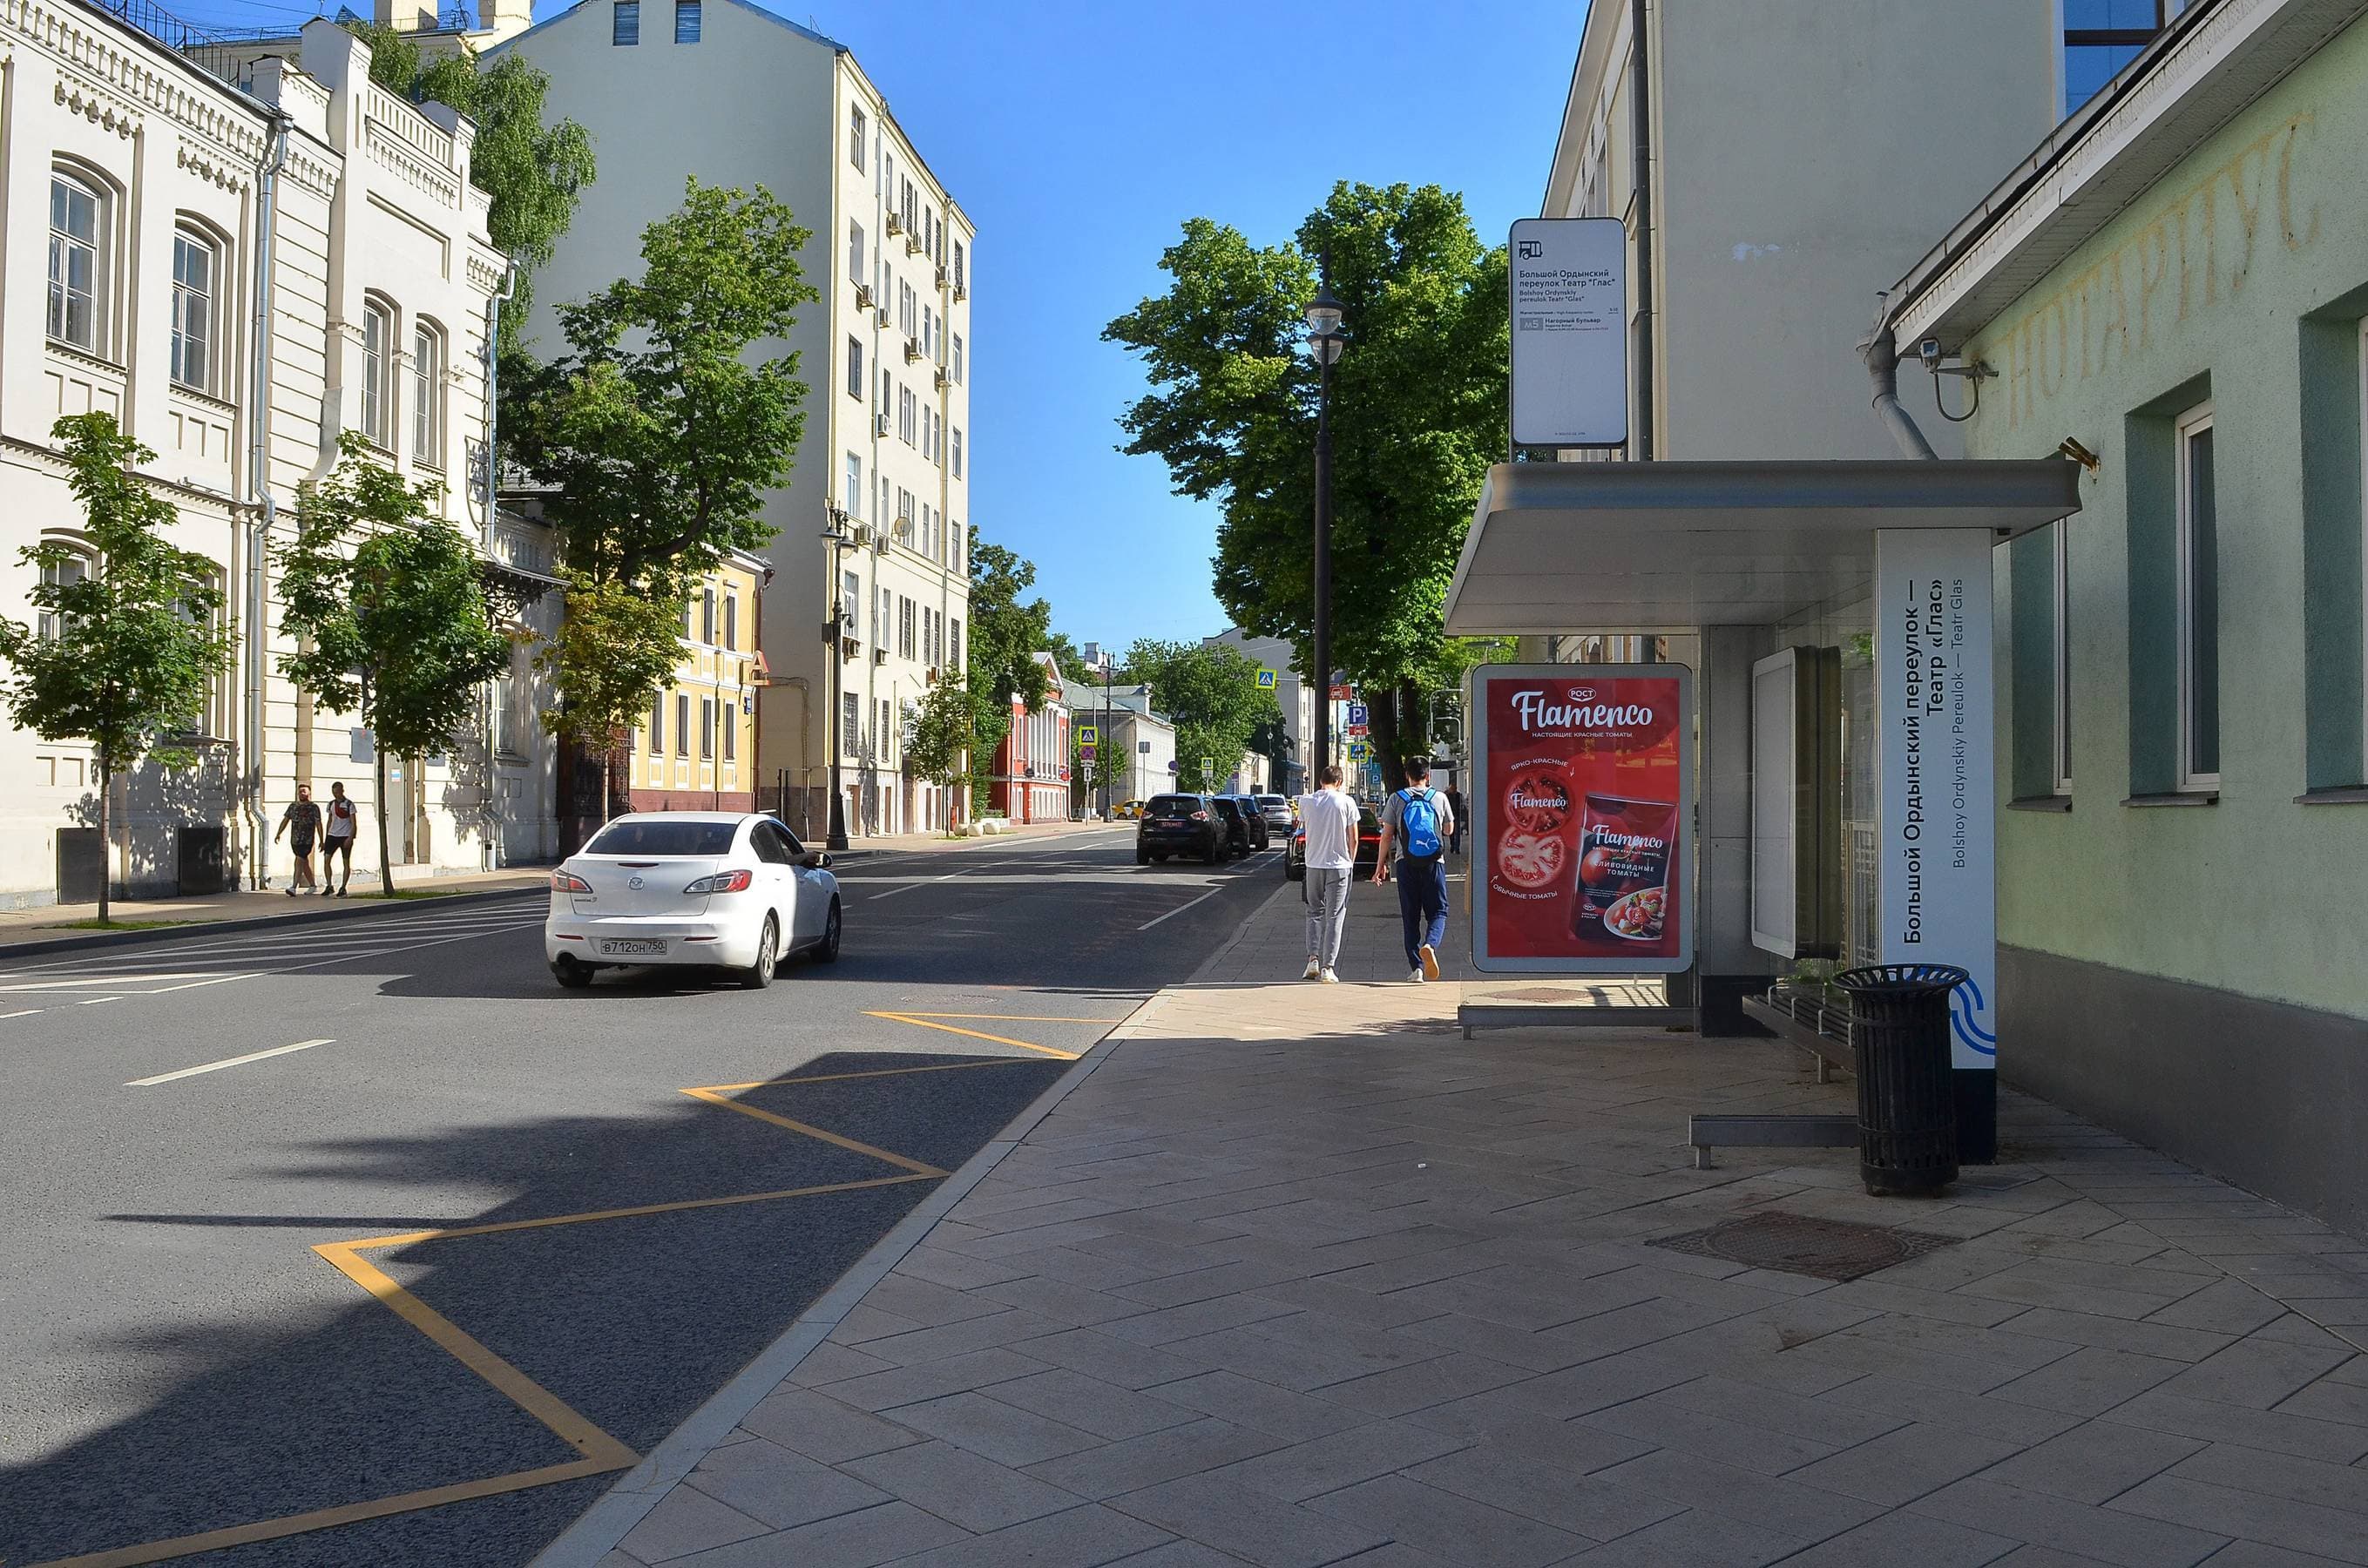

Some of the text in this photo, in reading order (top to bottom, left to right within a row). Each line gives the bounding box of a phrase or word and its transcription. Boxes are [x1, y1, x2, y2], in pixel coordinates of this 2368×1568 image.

[1559, 269, 1609, 279] Ордынский
[1561, 279, 1587, 287] Театр
[1588, 278, 1615, 287] "Глас"
[1951, 578, 1963, 610] Glas
[1925, 579, 1946, 716] Театр «Глас»
[1951, 613, 1963, 649] Teatr
[1905, 607, 1923, 708] переулок
[1512, 691, 1653, 731] Flamenco
[1951, 672, 1965, 733] Pereulok
[1511, 758, 1569, 771] ЯРКО-КРАСНЫЕ
[1903, 716, 1924, 841] Ордынский
[1952, 738, 1967, 808] Ordynskiy
[1510, 793, 1566, 809] Flamenco
[1593, 824, 1663, 848] Flamenco
[1952, 814, 1967, 868] Bolshoy
[1607, 868, 1640, 877] ТОМАТЫ
[1492, 883, 1558, 900] ОБЫЧНЫЕ ТОМАТЫ
[1904, 848, 1921, 943] Большой
